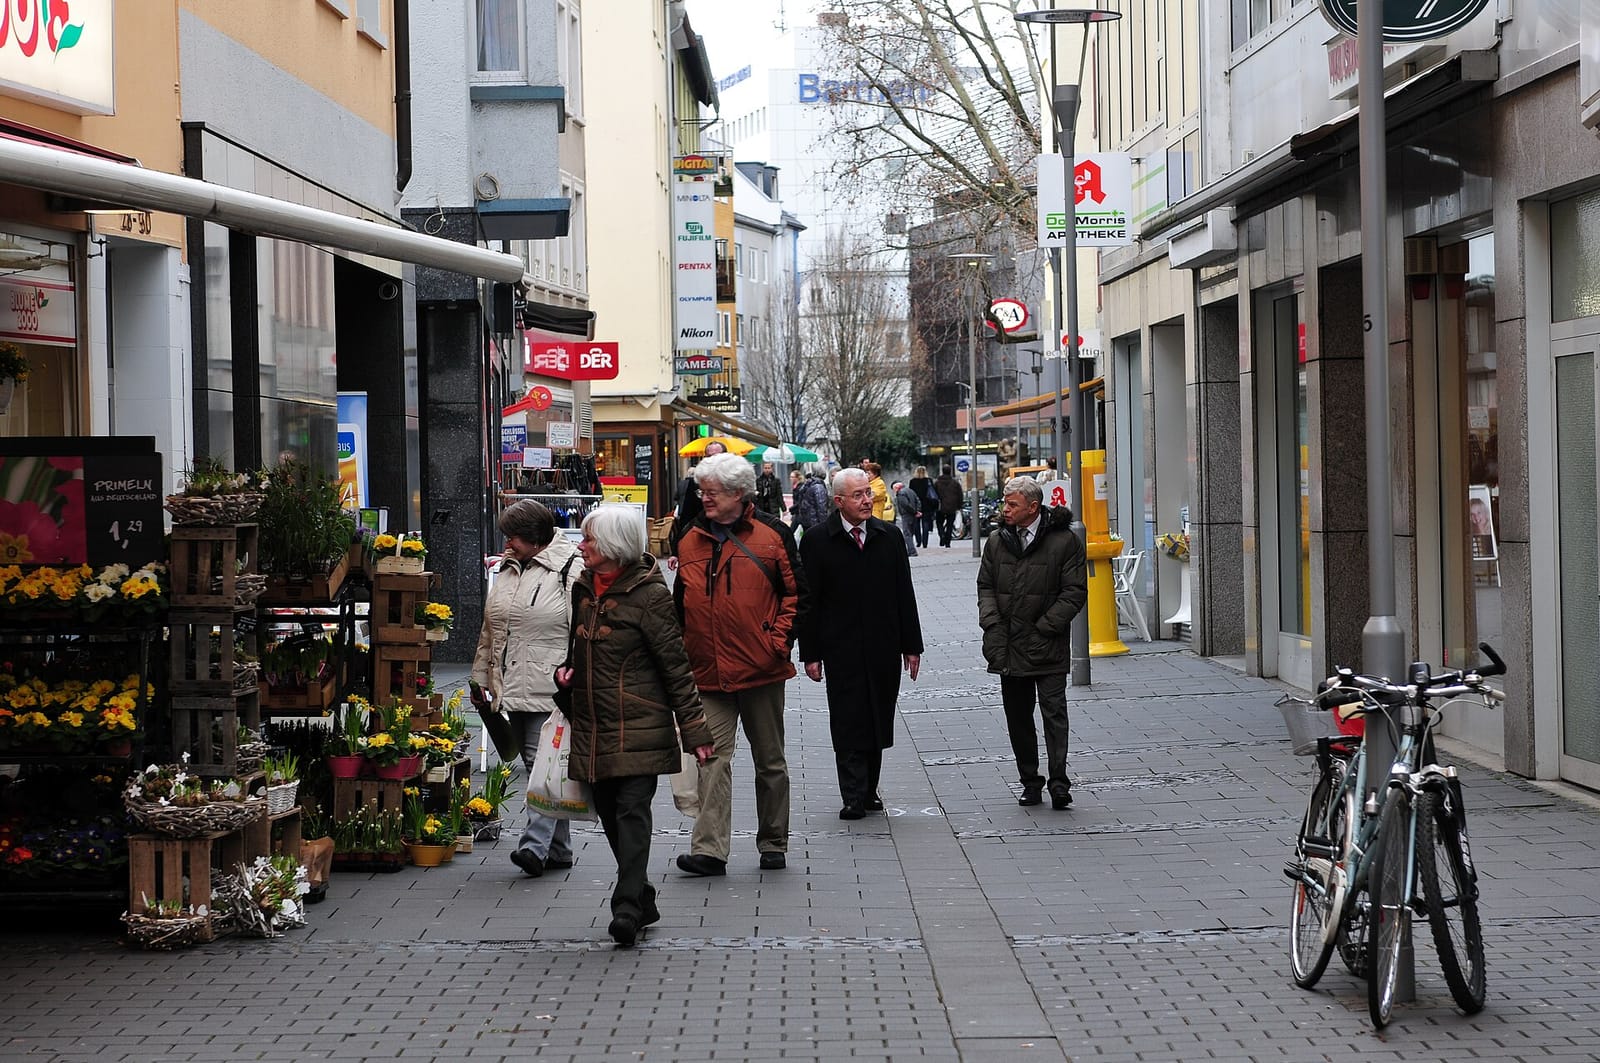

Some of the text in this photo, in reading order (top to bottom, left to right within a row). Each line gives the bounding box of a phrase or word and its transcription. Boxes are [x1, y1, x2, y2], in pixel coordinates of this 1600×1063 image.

[673, 160, 714, 169] DIGITAL
[677, 194, 710, 202] MINOLTA
[1046, 216, 1126, 225] DoMorris
[1047, 230, 1126, 239] APTHEKE
[680, 328, 713, 338] Nikon
[580, 353, 613, 369] DER
[675, 359, 721, 369] KAMERA
[94, 479, 153, 491] PRIMELN
